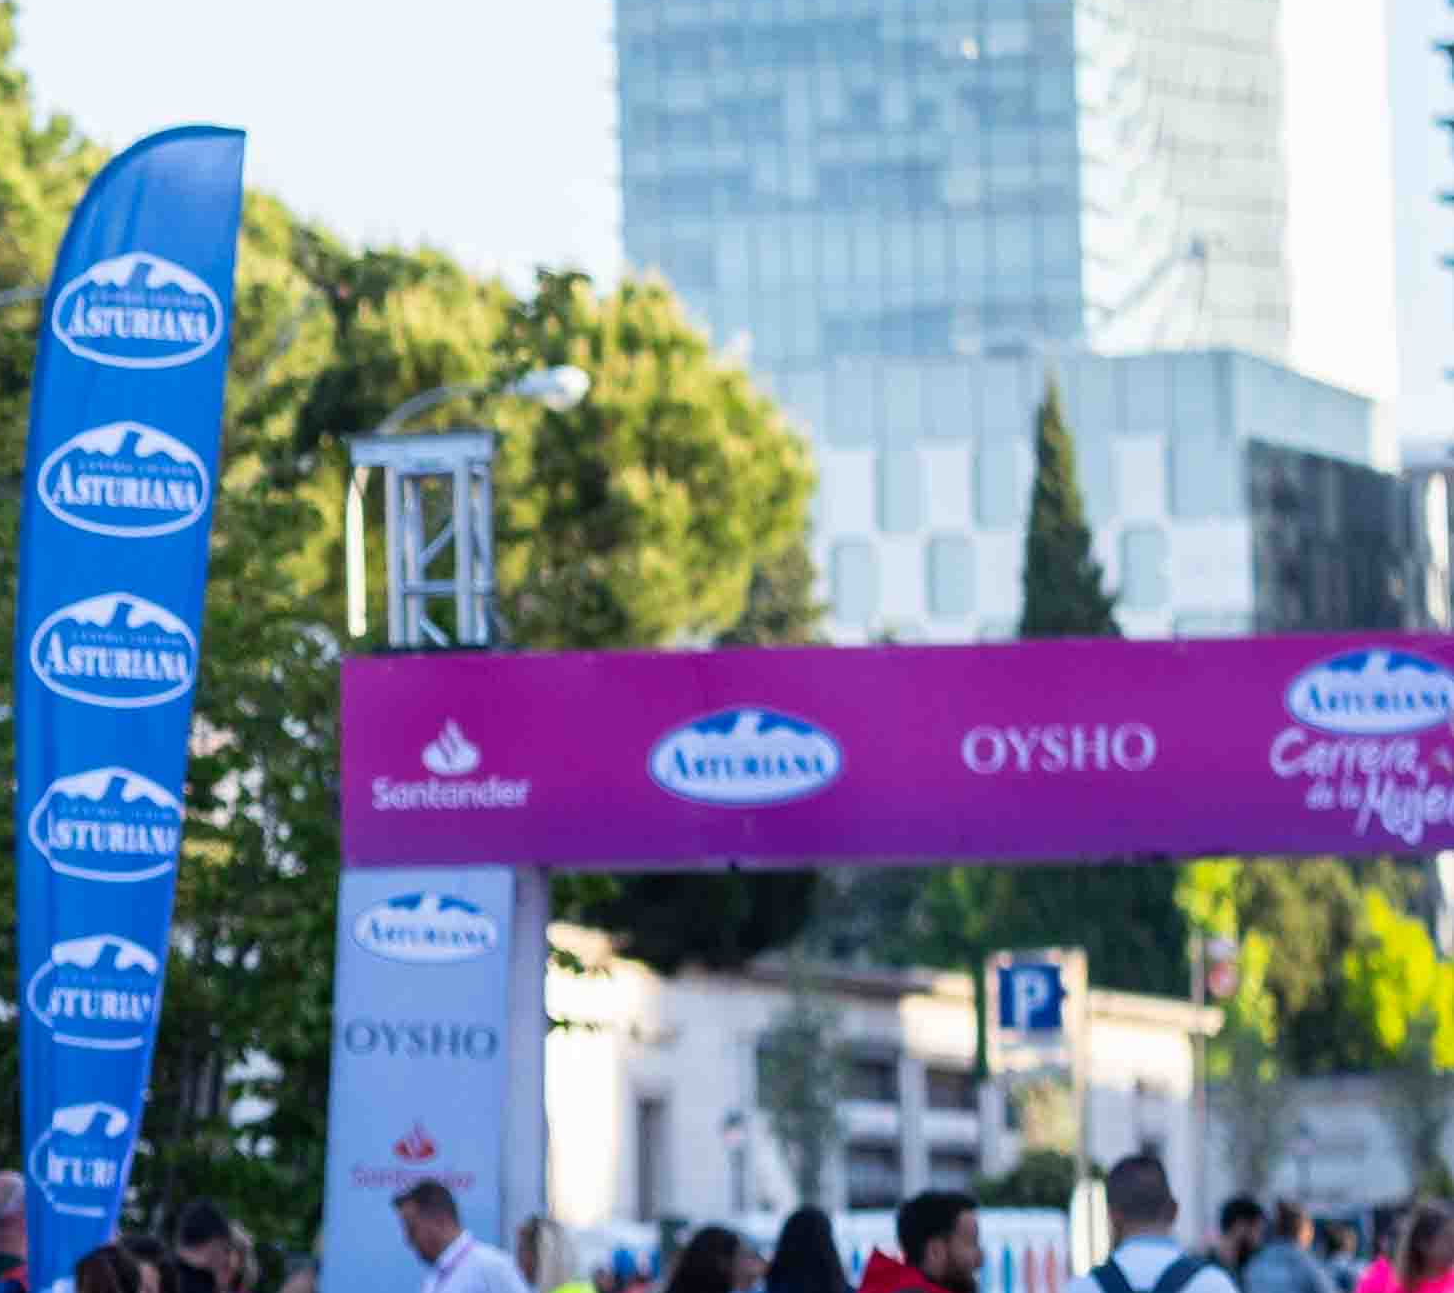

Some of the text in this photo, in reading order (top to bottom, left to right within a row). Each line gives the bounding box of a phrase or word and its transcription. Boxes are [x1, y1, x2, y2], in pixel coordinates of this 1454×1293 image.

[67, 293, 209, 342] ASTURIANA
[51, 462, 199, 511] ASTURIANA
[44, 631, 187, 681] ASTURIANA
[670, 747, 826, 778] ASTURIANA
[961, 722, 1157, 775] OYSHO
[1269, 726, 1420, 778] Carrera
[372, 775, 531, 810] Santander
[47, 810, 178, 855] STURIAN
[1011, 969, 1050, 1033] P
[344, 1017, 499, 1060] OYSHO
